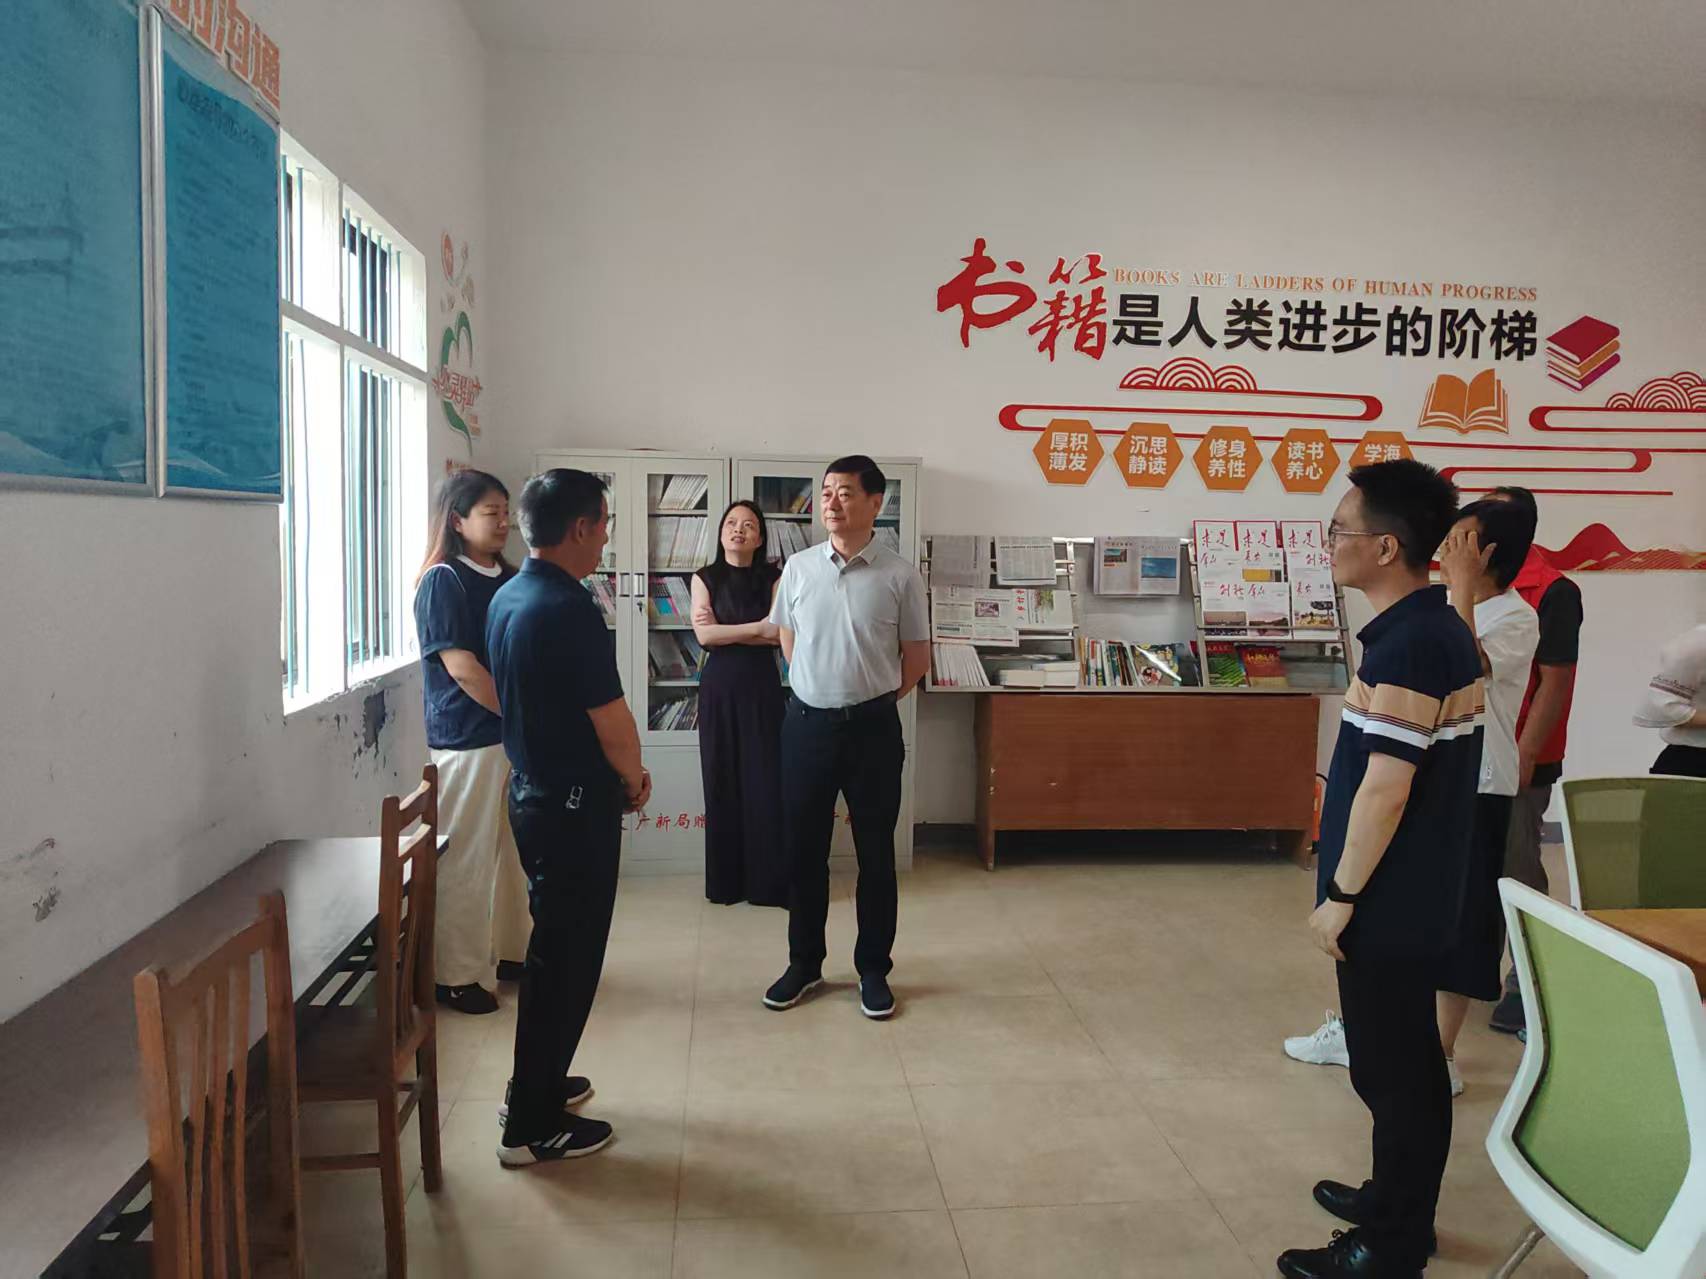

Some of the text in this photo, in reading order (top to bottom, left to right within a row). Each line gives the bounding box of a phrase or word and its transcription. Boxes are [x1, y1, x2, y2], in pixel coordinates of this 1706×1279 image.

[1113, 267, 1538, 301] BOOKS ARE LADDERS OF HUMAN PROGRESS
[1050, 432, 1088, 452] 厚积
[1130, 435, 1168, 455] 沉思
[1209, 439, 1247, 458] 修身
[1287, 442, 1325, 461] 读书
[1049, 452, 1087, 472] 薄发
[1364, 444, 1401, 463] 学海
[1128, 456, 1168, 475] 静读
[1208, 459, 1246, 479] 养性
[1286, 462, 1324, 480] 养心
